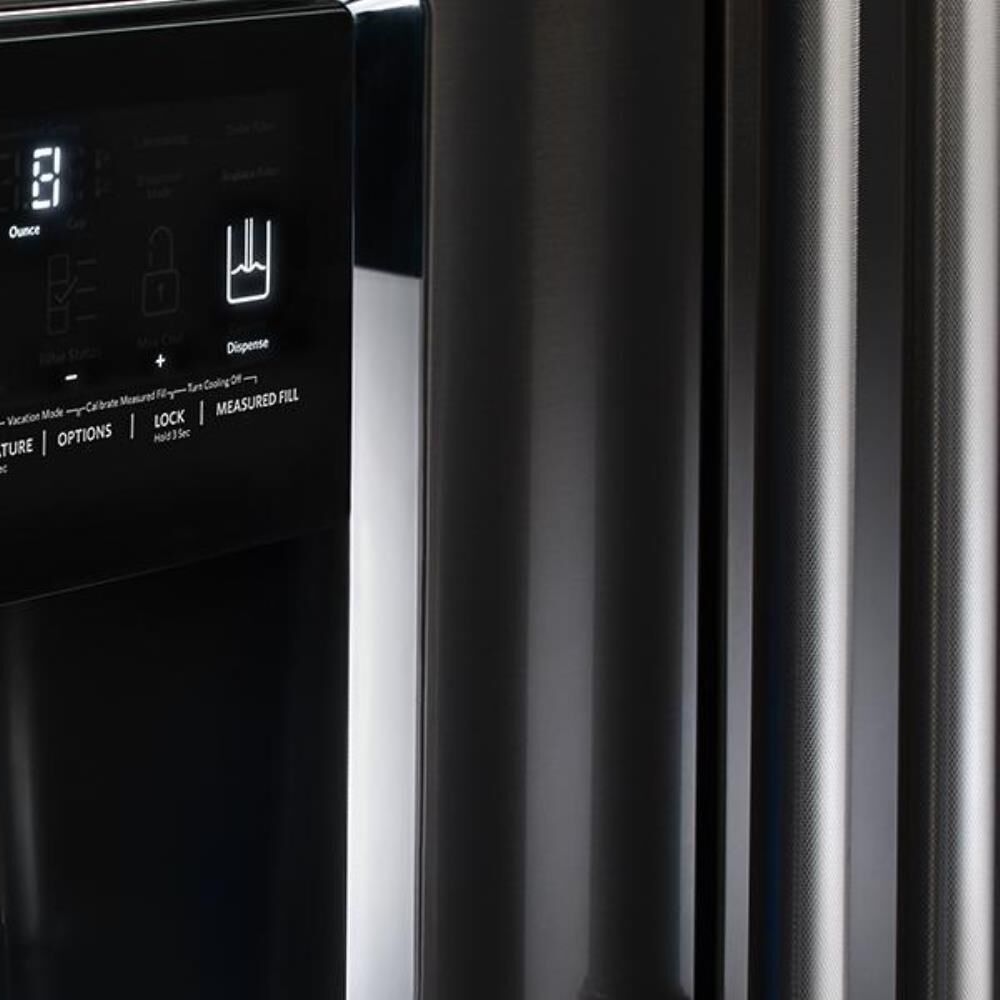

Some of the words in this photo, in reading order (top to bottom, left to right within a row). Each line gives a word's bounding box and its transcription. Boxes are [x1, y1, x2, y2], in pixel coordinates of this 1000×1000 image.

[8, 225, 41, 239] Ounce
[226, 338, 269, 354] Dispense
[203, 377, 230, 389] Cooling
[230, 374, 243, 385] Off
[85, 398, 119, 412] Calibrate
[120, 391, 155, 406] Measured
[156, 387, 168, 399] Fill
[215, 391, 277, 416] MEASURED
[278, 387, 299, 403] FILL
[6, 412, 41, 426] Vacation
[41, 407, 64, 420] Mode
[154, 409, 186, 428] LOCK
[57, 423, 112, 447] OPTIONS
[153, 431, 172, 443] Hold
[178, 427, 191, 438] Sec
